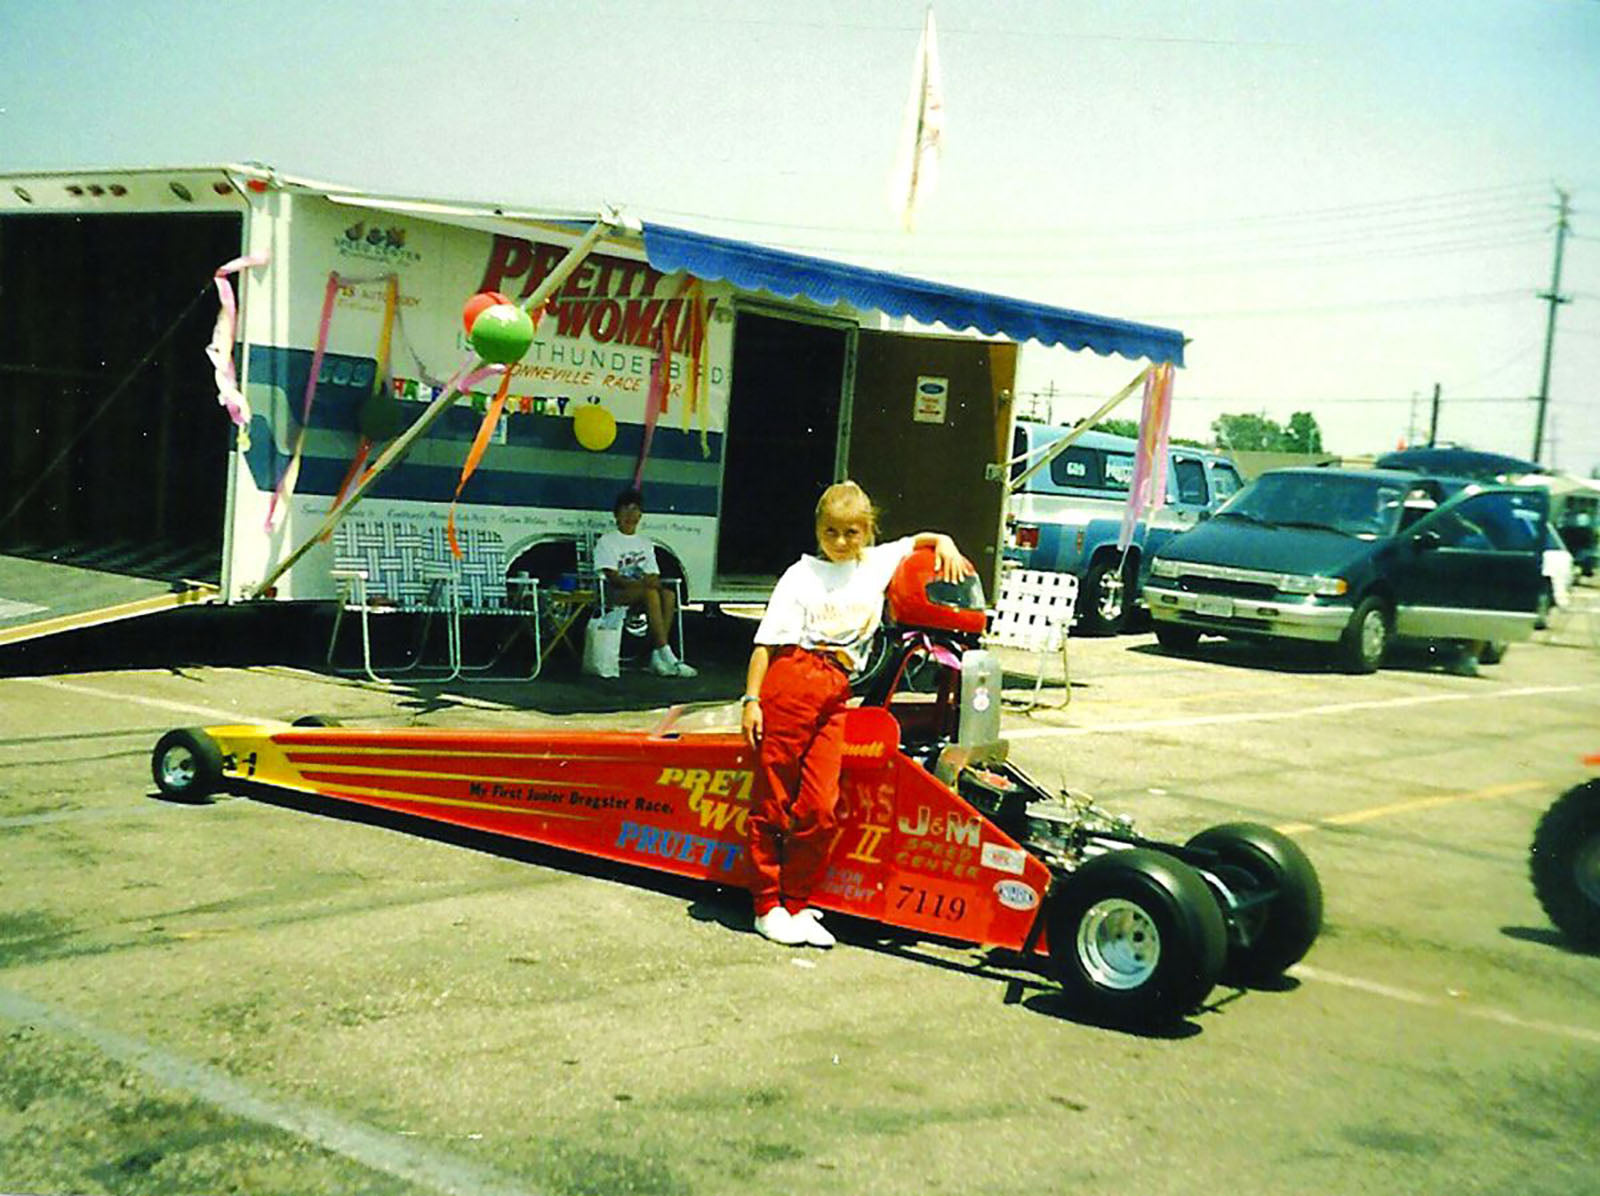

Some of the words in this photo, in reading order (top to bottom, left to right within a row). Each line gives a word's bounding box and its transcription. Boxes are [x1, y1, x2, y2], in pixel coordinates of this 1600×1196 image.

[602, 374, 641, 392] RACE
[491, 785, 524, 800] First
[527, 788, 565, 804] Junior
[569, 791, 630, 809] Dragster
[614, 820, 745, 872] PRUETT
[896, 851, 980, 879] CENTER
[896, 885, 967, 922] 7119
